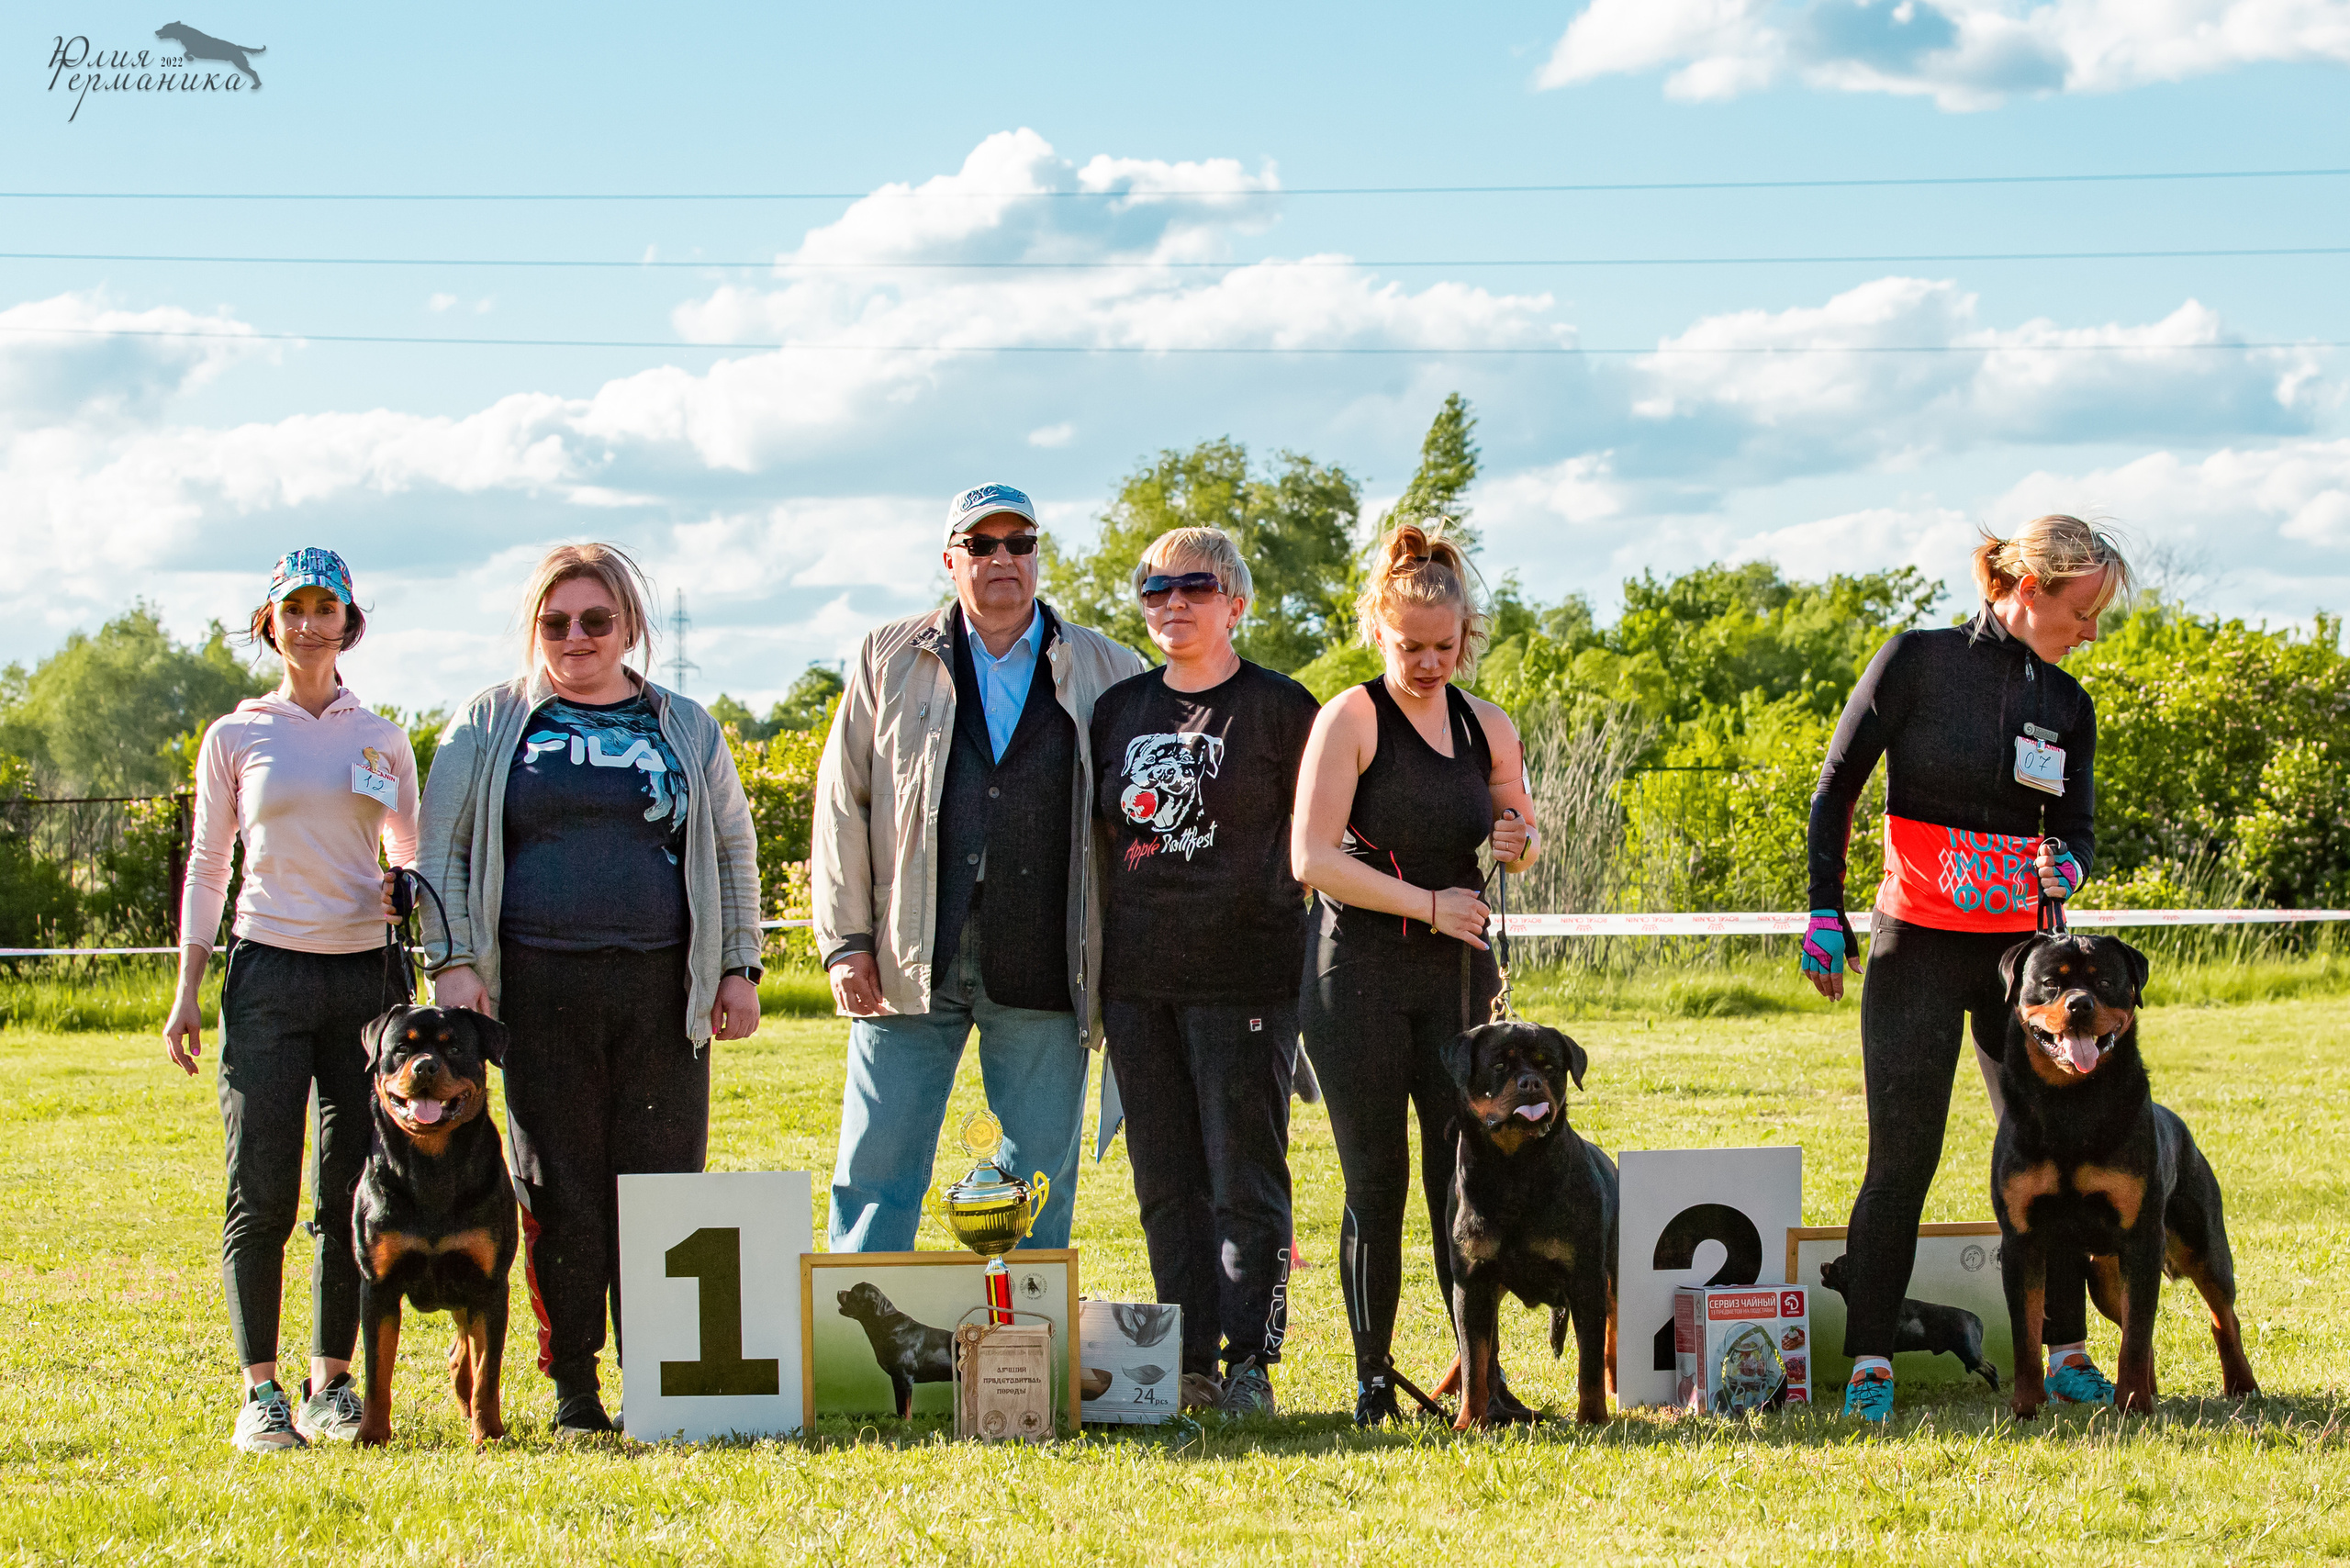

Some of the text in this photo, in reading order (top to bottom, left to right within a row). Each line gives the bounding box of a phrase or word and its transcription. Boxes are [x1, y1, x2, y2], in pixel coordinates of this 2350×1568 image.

[523, 730, 666, 772] FILA
[2025, 752, 2051, 771] 07
[364, 775, 386, 793] 12
[1124, 836, 1160, 872] Apple
[1954, 852, 2037, 880] МАРА
[1953, 883, 2029, 913] ФОН
[1653, 1204, 1762, 1372] 2
[1709, 1296, 1776, 1309] СЕРВИЗ ЧАЙНЫЙ
[660, 1227, 779, 1396] 1
[1133, 1387, 1169, 1406] 24 pcs
